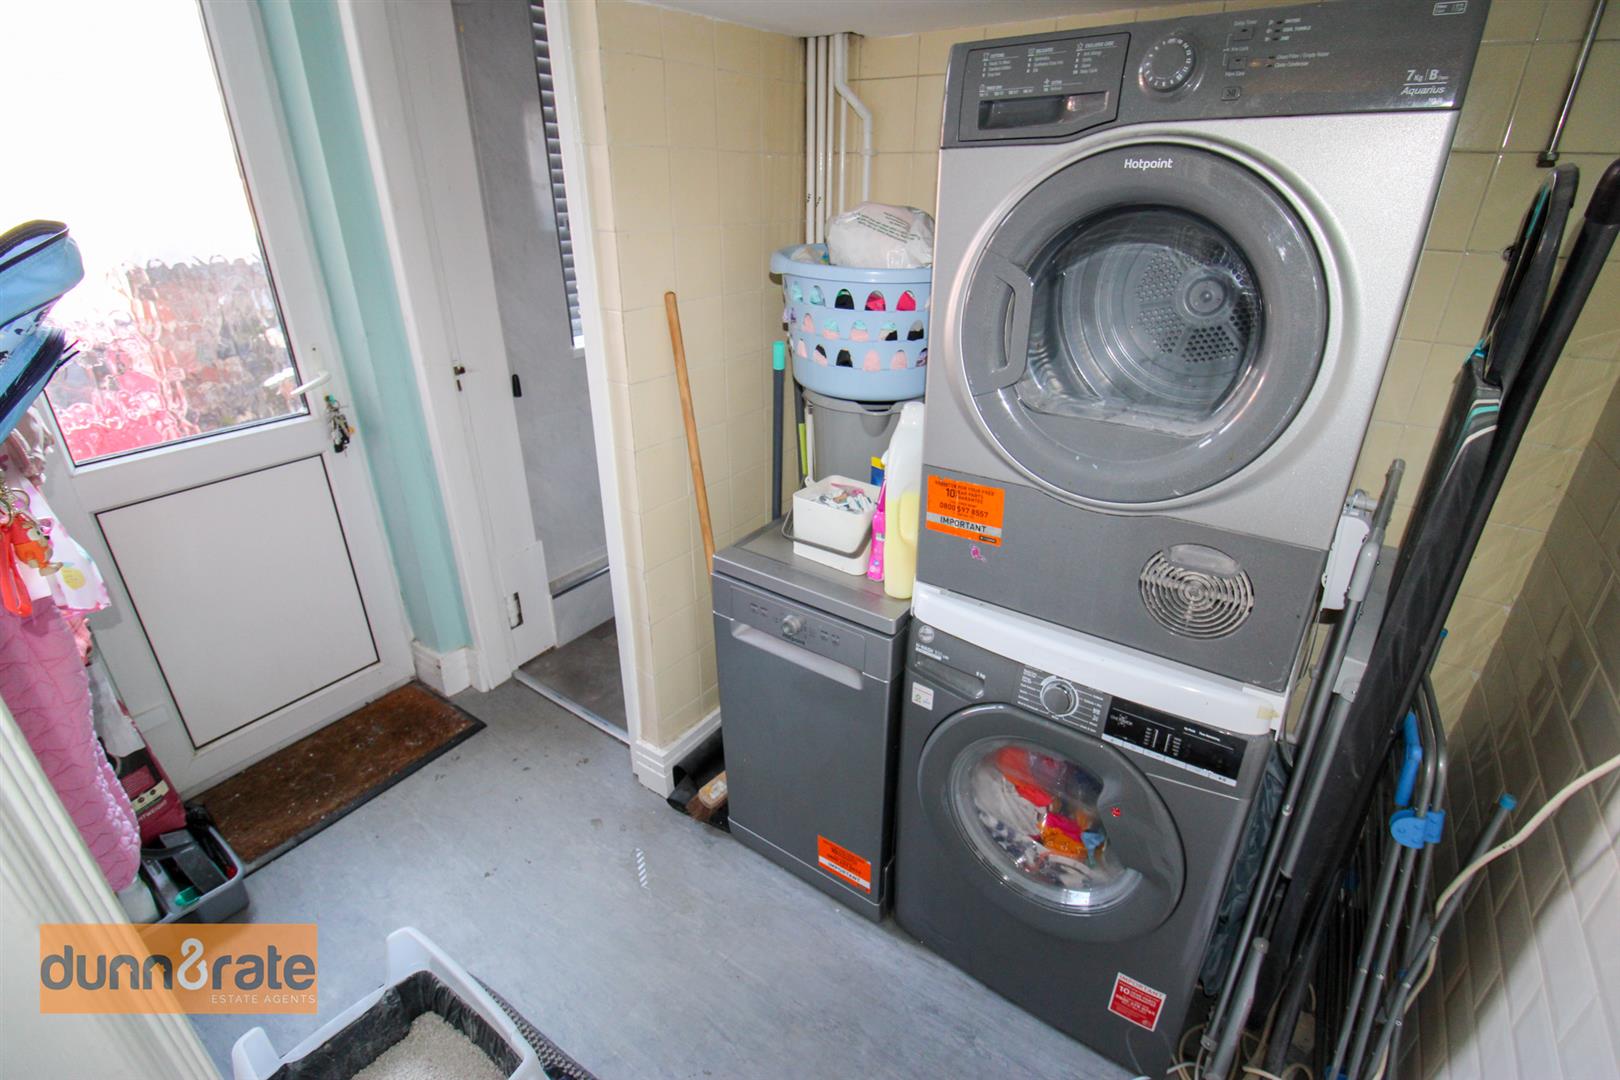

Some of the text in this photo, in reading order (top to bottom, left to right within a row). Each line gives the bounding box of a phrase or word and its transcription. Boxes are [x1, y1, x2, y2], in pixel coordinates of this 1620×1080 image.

[1429, 69, 1440, 81] B
[1400, 85, 1446, 96] Aquarius
[1123, 157, 1174, 171] Hotpoint
[945, 487, 956, 498] 10
[939, 502, 956, 511] 0800
[940, 516, 987, 533] IMPORTANT
[1119, 985, 1130, 995] 10
